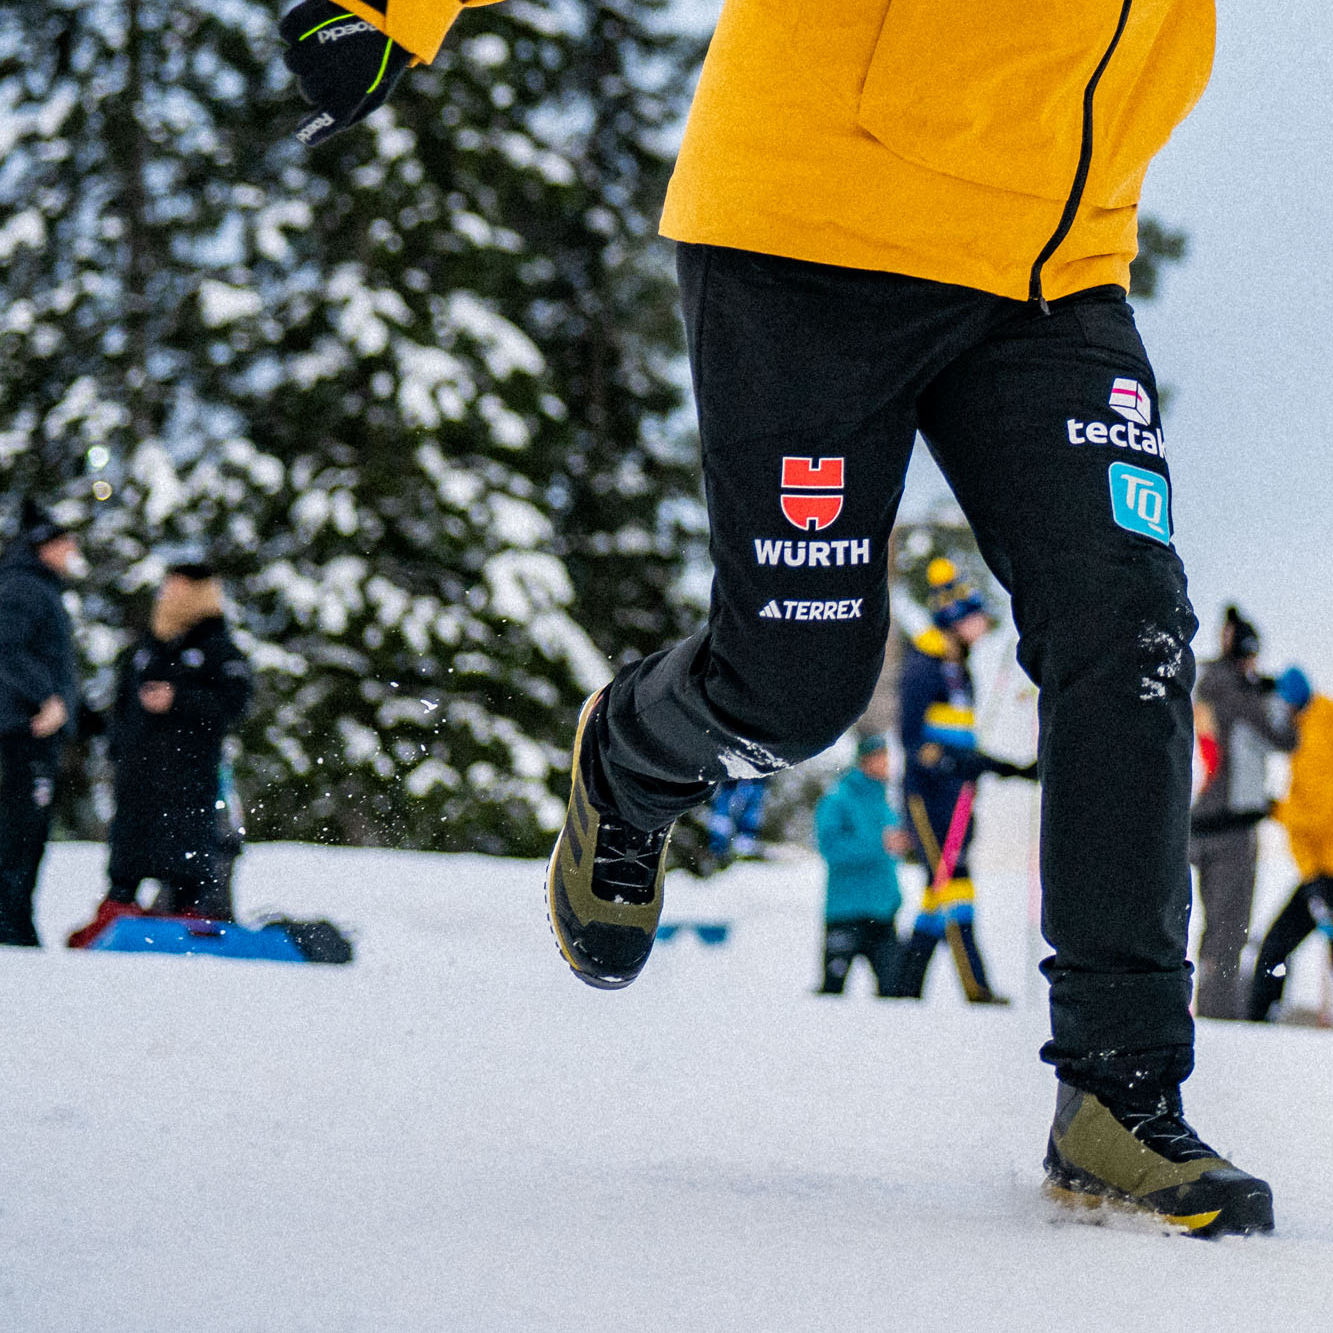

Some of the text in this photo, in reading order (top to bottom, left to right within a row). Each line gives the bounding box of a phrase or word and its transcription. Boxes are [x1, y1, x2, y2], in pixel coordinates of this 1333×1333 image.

[1066, 418, 1167, 459] tectak
[753, 538, 871, 568] WÜRTH
[782, 597, 864, 621] TERREX
